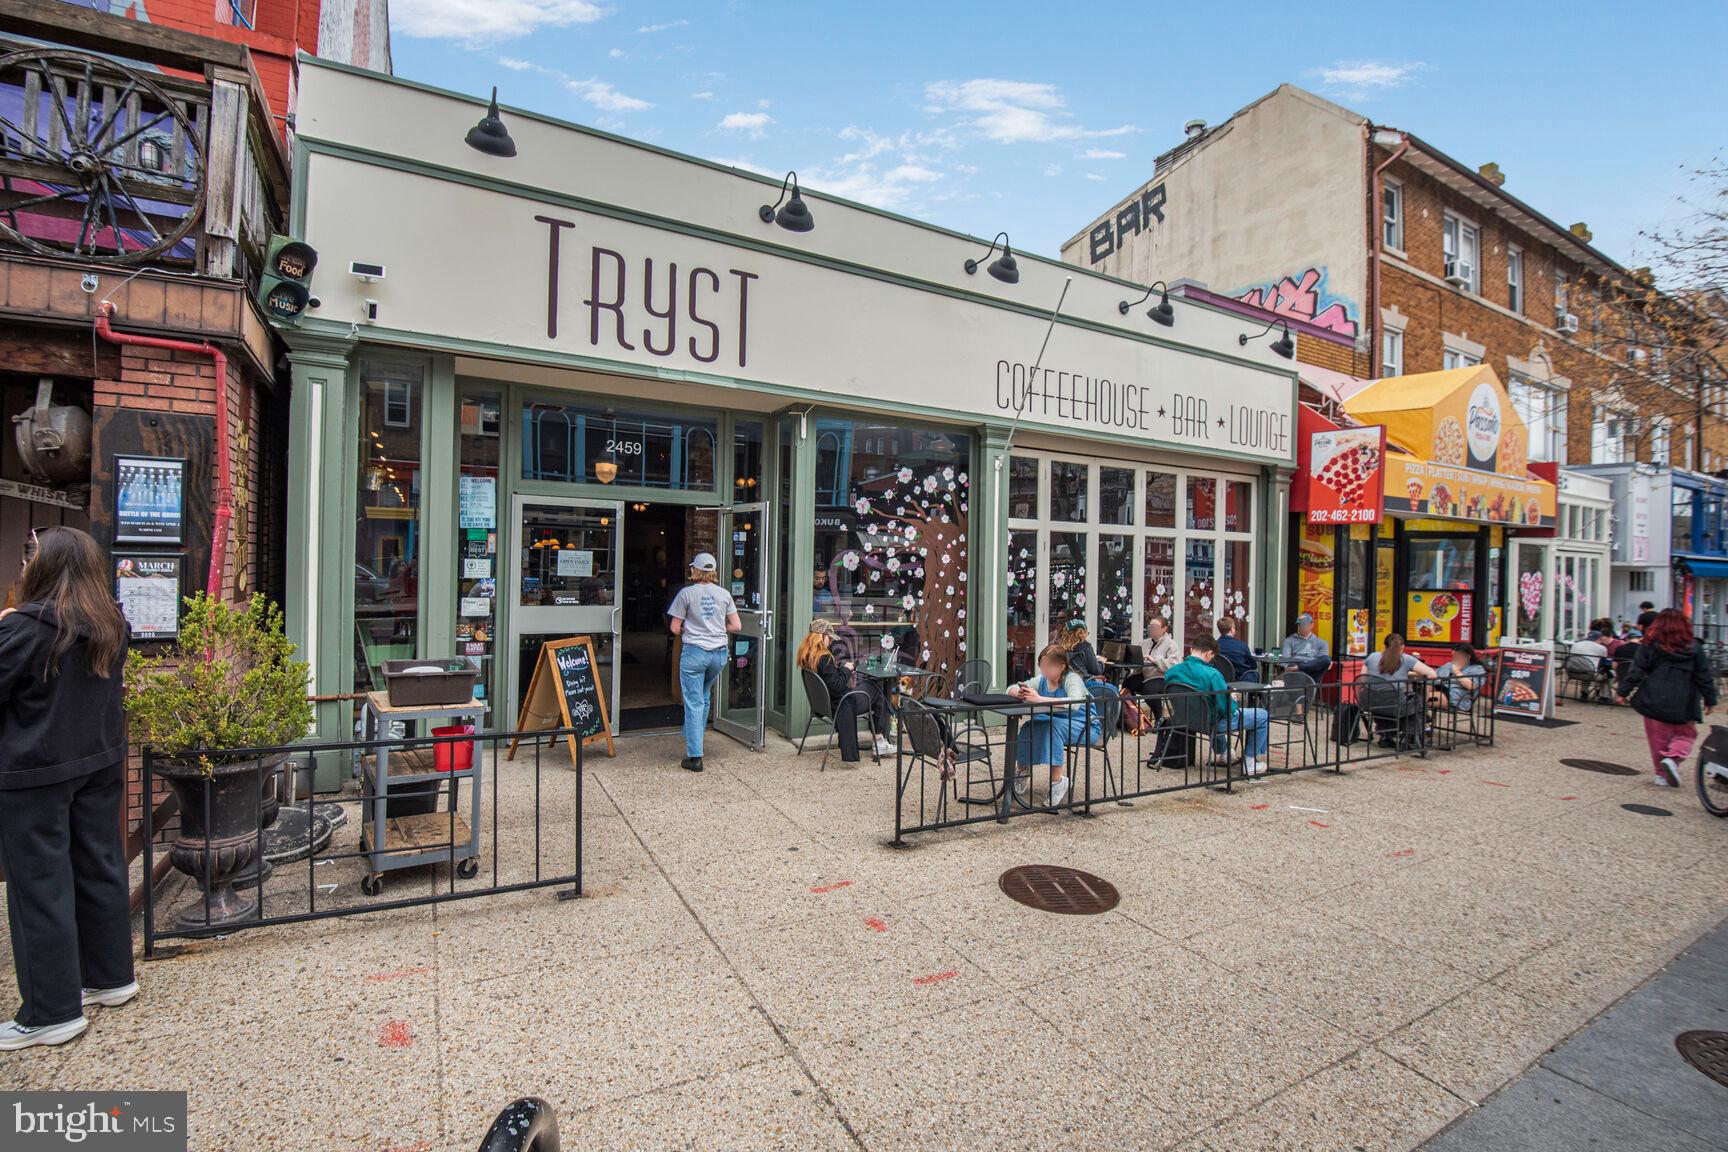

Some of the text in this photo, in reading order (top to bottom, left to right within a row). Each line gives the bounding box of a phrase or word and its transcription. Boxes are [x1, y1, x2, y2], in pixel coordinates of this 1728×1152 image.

[1090, 183, 1167, 265] BAR
[279, 260, 304, 277] Food
[534, 215, 759, 368] TRYST
[269, 298, 299, 313] Music
[996, 359, 1288, 453] COFFEEHOUSE BAR LOUNGE
[606, 439, 642, 455] 2459
[1311, 509, 1375, 522] 202-462-2100
[138, 561, 175, 570] MARCH
[557, 650, 589, 670] Welcome!
